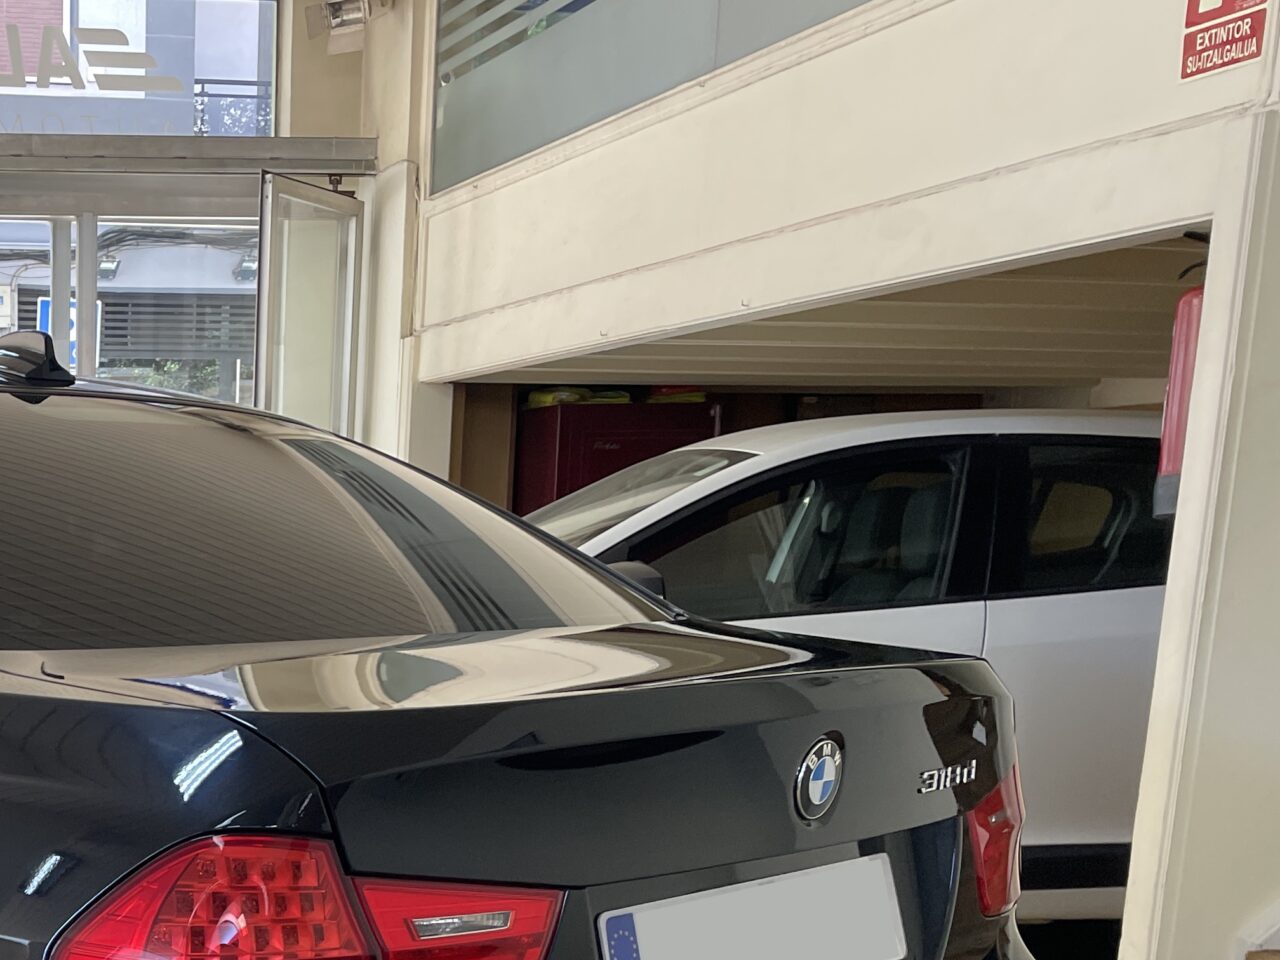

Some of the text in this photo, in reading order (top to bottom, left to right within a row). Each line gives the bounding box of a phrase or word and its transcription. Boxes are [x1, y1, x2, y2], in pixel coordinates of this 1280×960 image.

[1196, 18, 1251, 51] EXTINTOR
[1186, 36, 1257, 74] SU-ITZALGAILUA
[807, 743, 842, 769] BMW
